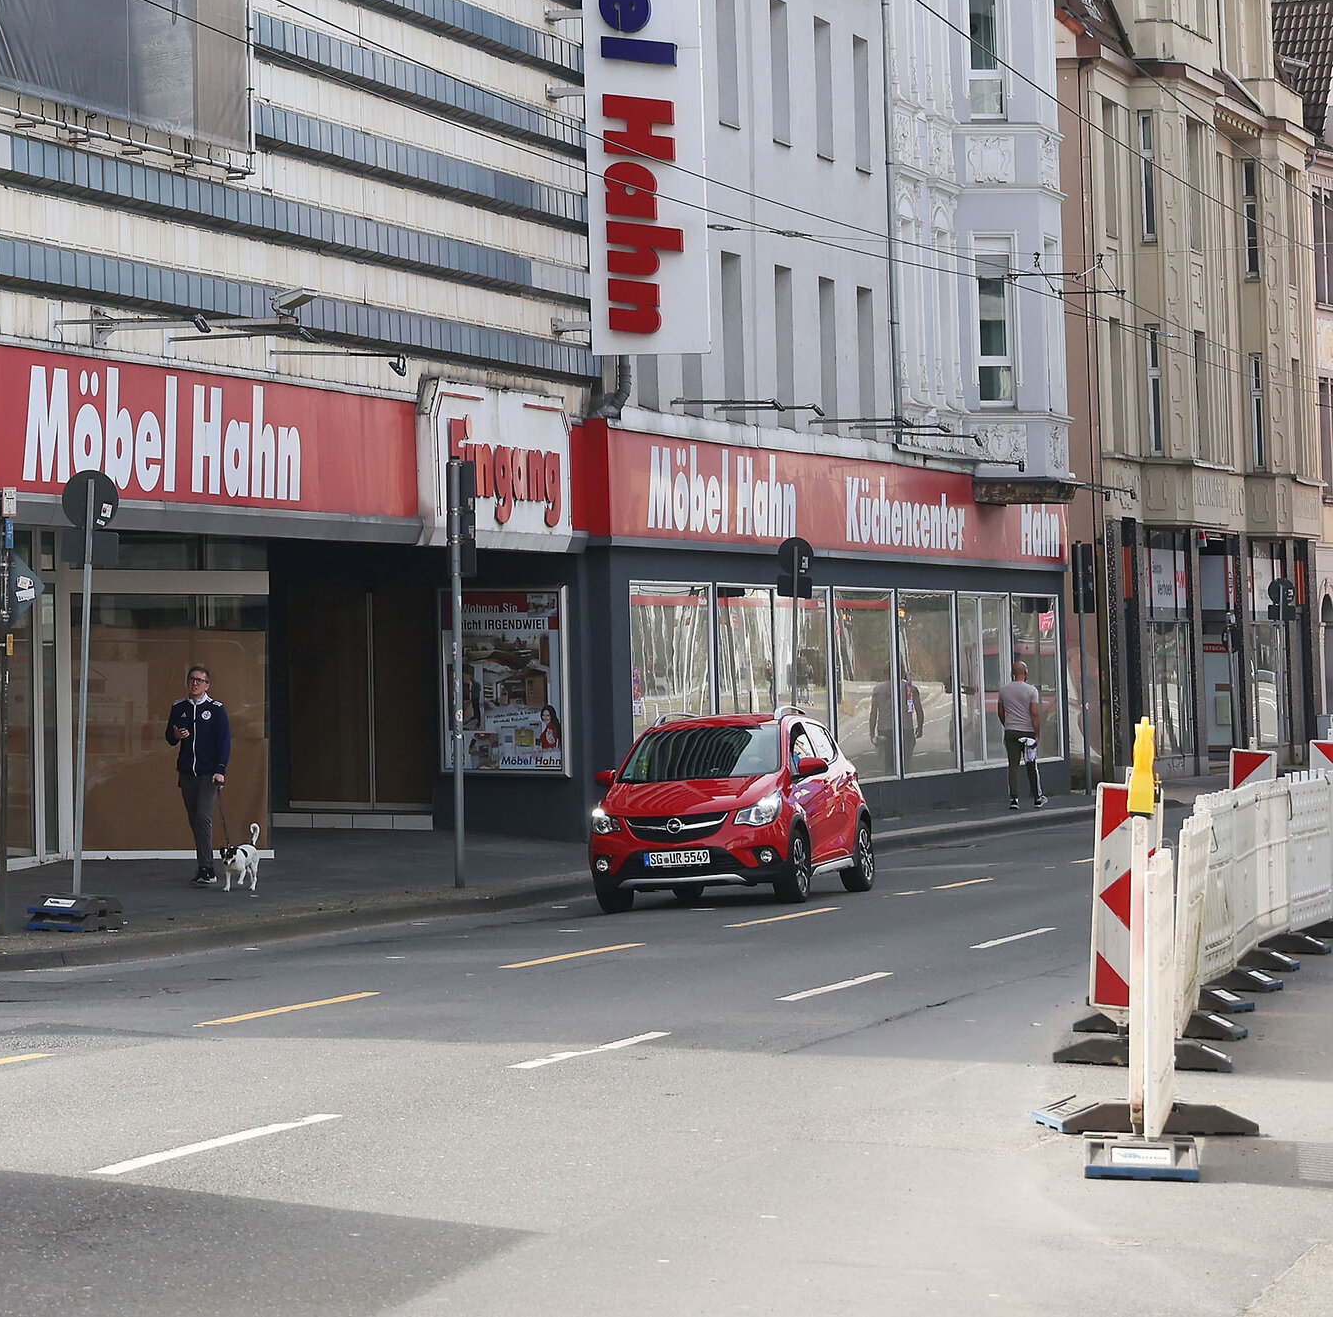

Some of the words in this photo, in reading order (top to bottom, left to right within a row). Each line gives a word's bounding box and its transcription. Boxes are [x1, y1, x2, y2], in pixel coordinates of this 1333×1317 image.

[602, 93, 685, 336] Hahn
[22, 365, 178, 492] Möbel
[191, 384, 301, 501] Hahn
[647, 445, 729, 534] Möbel
[736, 454, 797, 538] Hahn
[846, 476, 965, 551] Küchencenter
[1021, 503, 1060, 558] Hahn
[502, 602, 518, 613] Sie
[484, 618, 546, 630] IRGENDWIE!
[501, 756, 532, 766] Möbel
[535, 756, 561, 766] Hahn
[650, 853, 663, 865] SG
